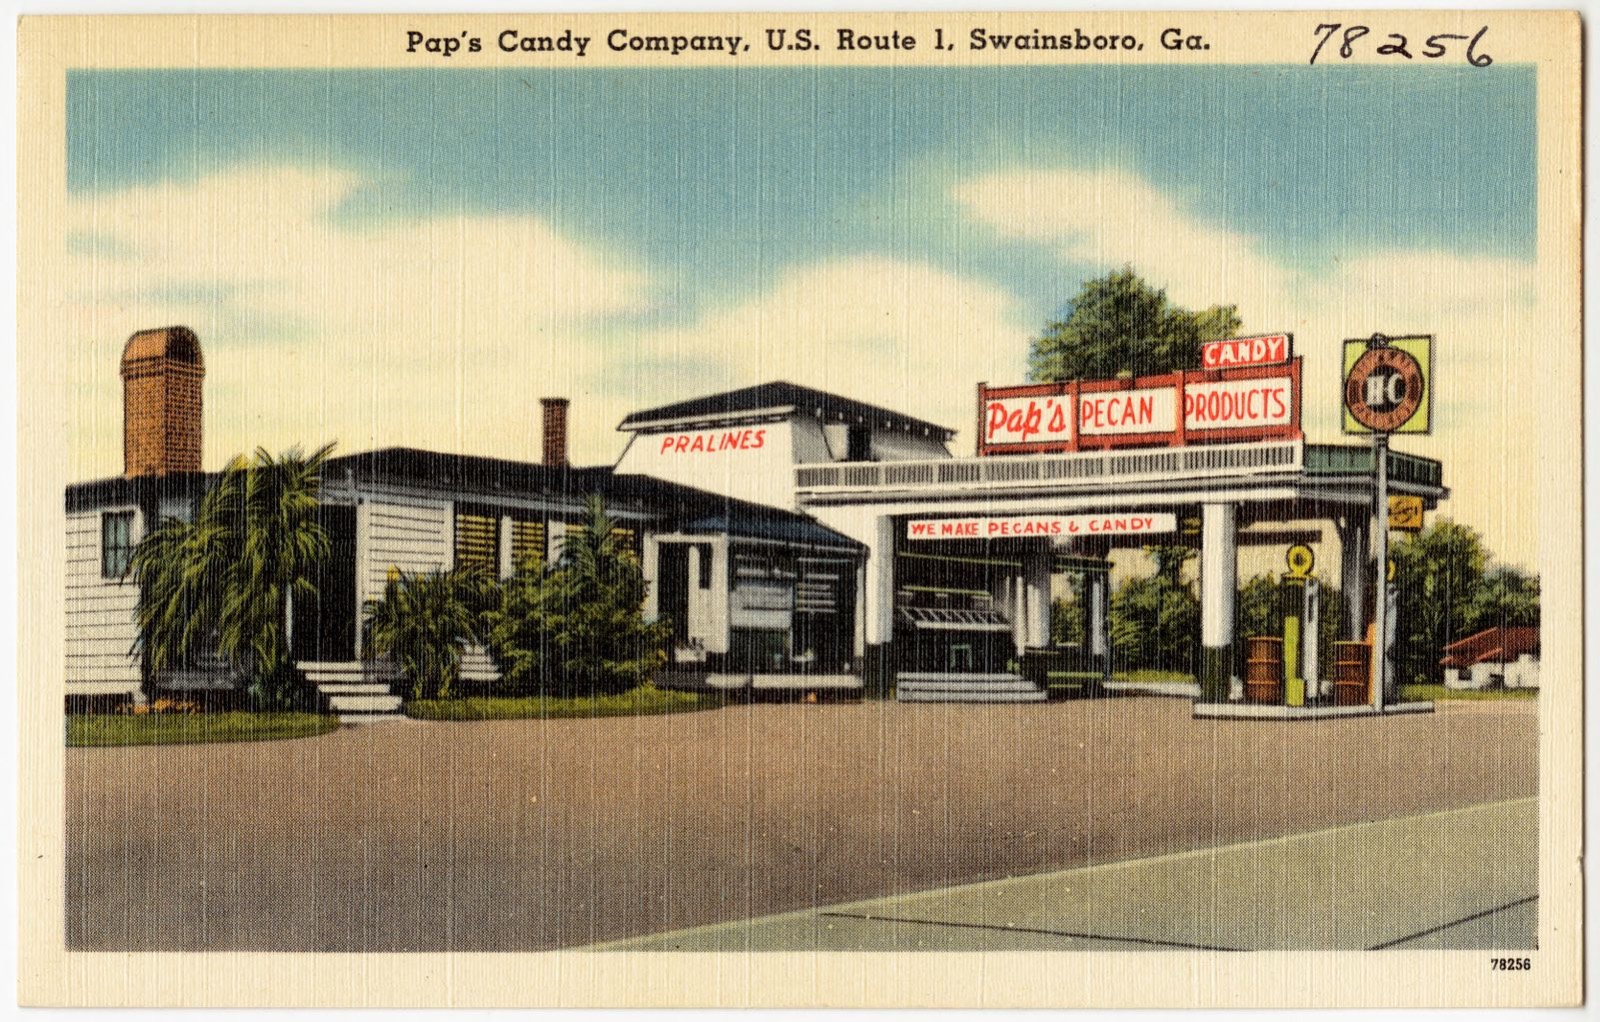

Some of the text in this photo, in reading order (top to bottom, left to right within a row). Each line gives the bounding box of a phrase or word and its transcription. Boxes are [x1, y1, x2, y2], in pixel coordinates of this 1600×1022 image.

[1309, 23, 1493, 67] 78256
[1205, 340, 1281, 363] CANDY
[987, 387, 1286, 440] Pap's PECAN PRODUCTS
[660, 429, 766, 456] PRALINES
[911, 523, 936, 536] WE
[941, 522, 979, 536] MAKE
[988, 520, 1062, 535] PECANS
[1088, 517, 1154, 532] CANDY
